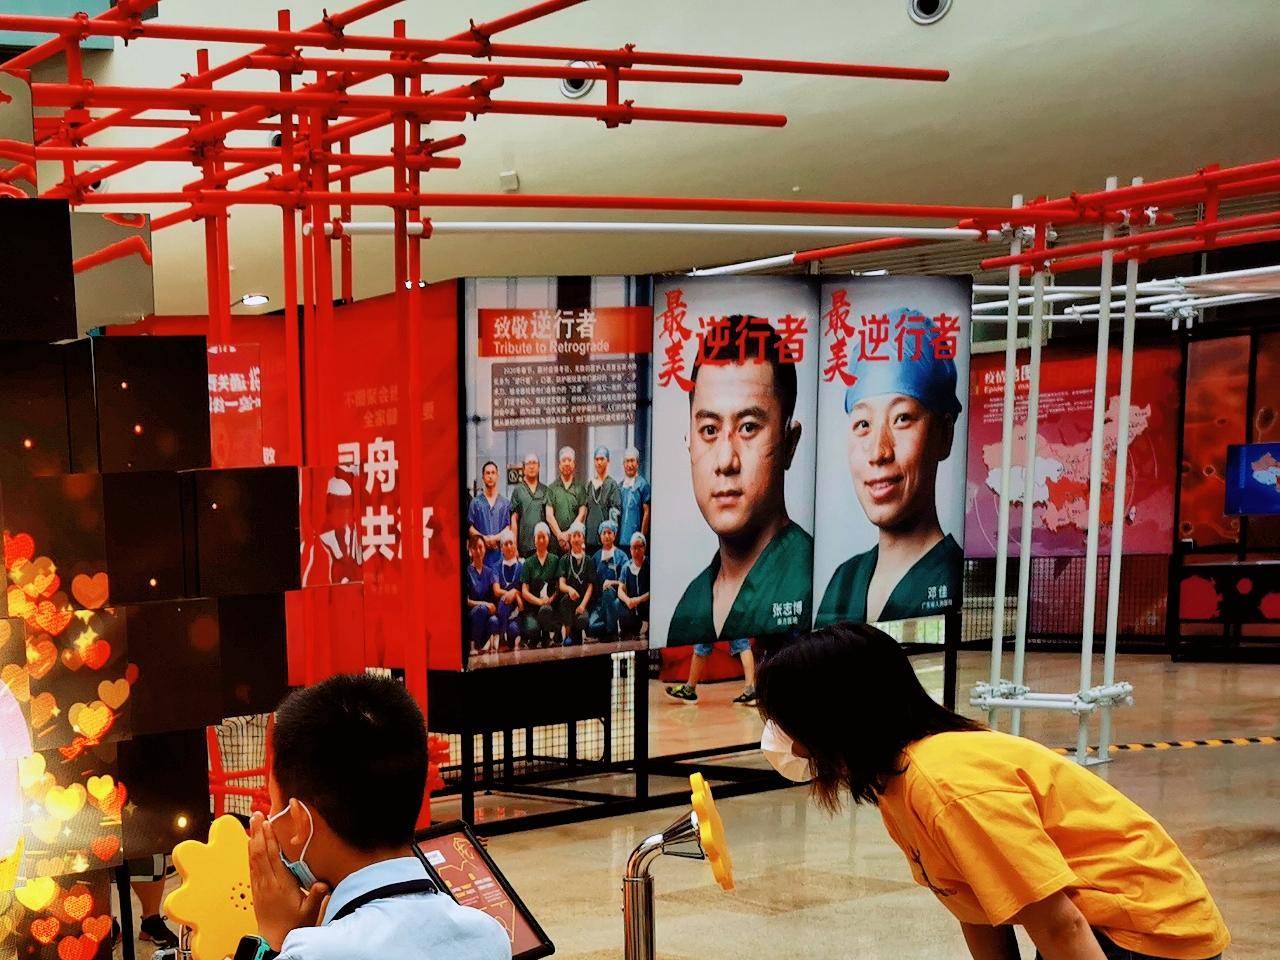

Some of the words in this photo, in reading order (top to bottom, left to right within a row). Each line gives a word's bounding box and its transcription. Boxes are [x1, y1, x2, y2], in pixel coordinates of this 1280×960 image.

[493, 308, 597, 340] 致敬逆行者
[493, 341, 533, 355] Tribute
[536, 342, 545, 353] to
[551, 339, 610, 356] Retrograde
[656, 288, 696, 393] 最美
[695, 313, 809, 367] 逆行者
[823, 288, 858, 387] 最美
[857, 312, 961, 363] 逆行者
